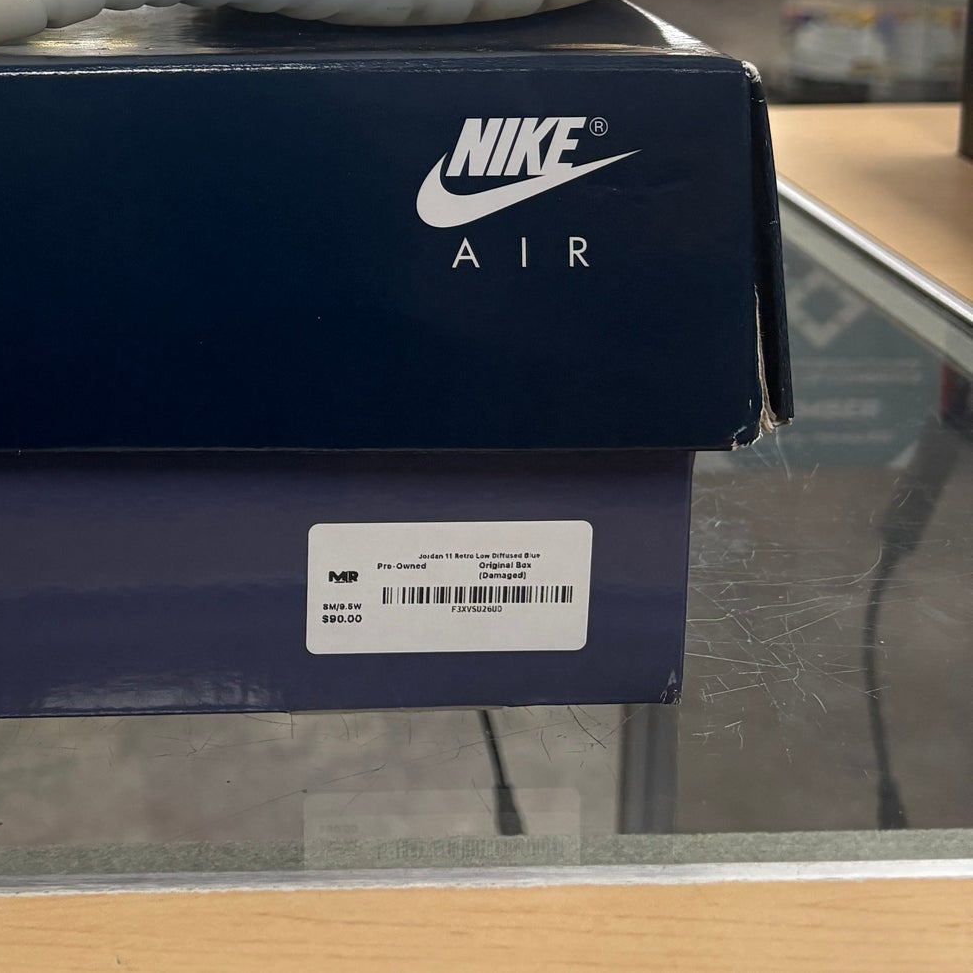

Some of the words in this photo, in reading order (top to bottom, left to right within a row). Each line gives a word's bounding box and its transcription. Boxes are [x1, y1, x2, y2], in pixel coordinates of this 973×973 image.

[445, 116, 587, 177] NIKE
[452, 237, 589, 268] AIR
[377, 562, 427, 570] Pre-Owned
[479, 561, 514, 570] Original
[479, 572, 527, 580] (Damaged)
[322, 603, 362, 611] 8M/9.5W
[321, 614, 363, 624] $90.00
